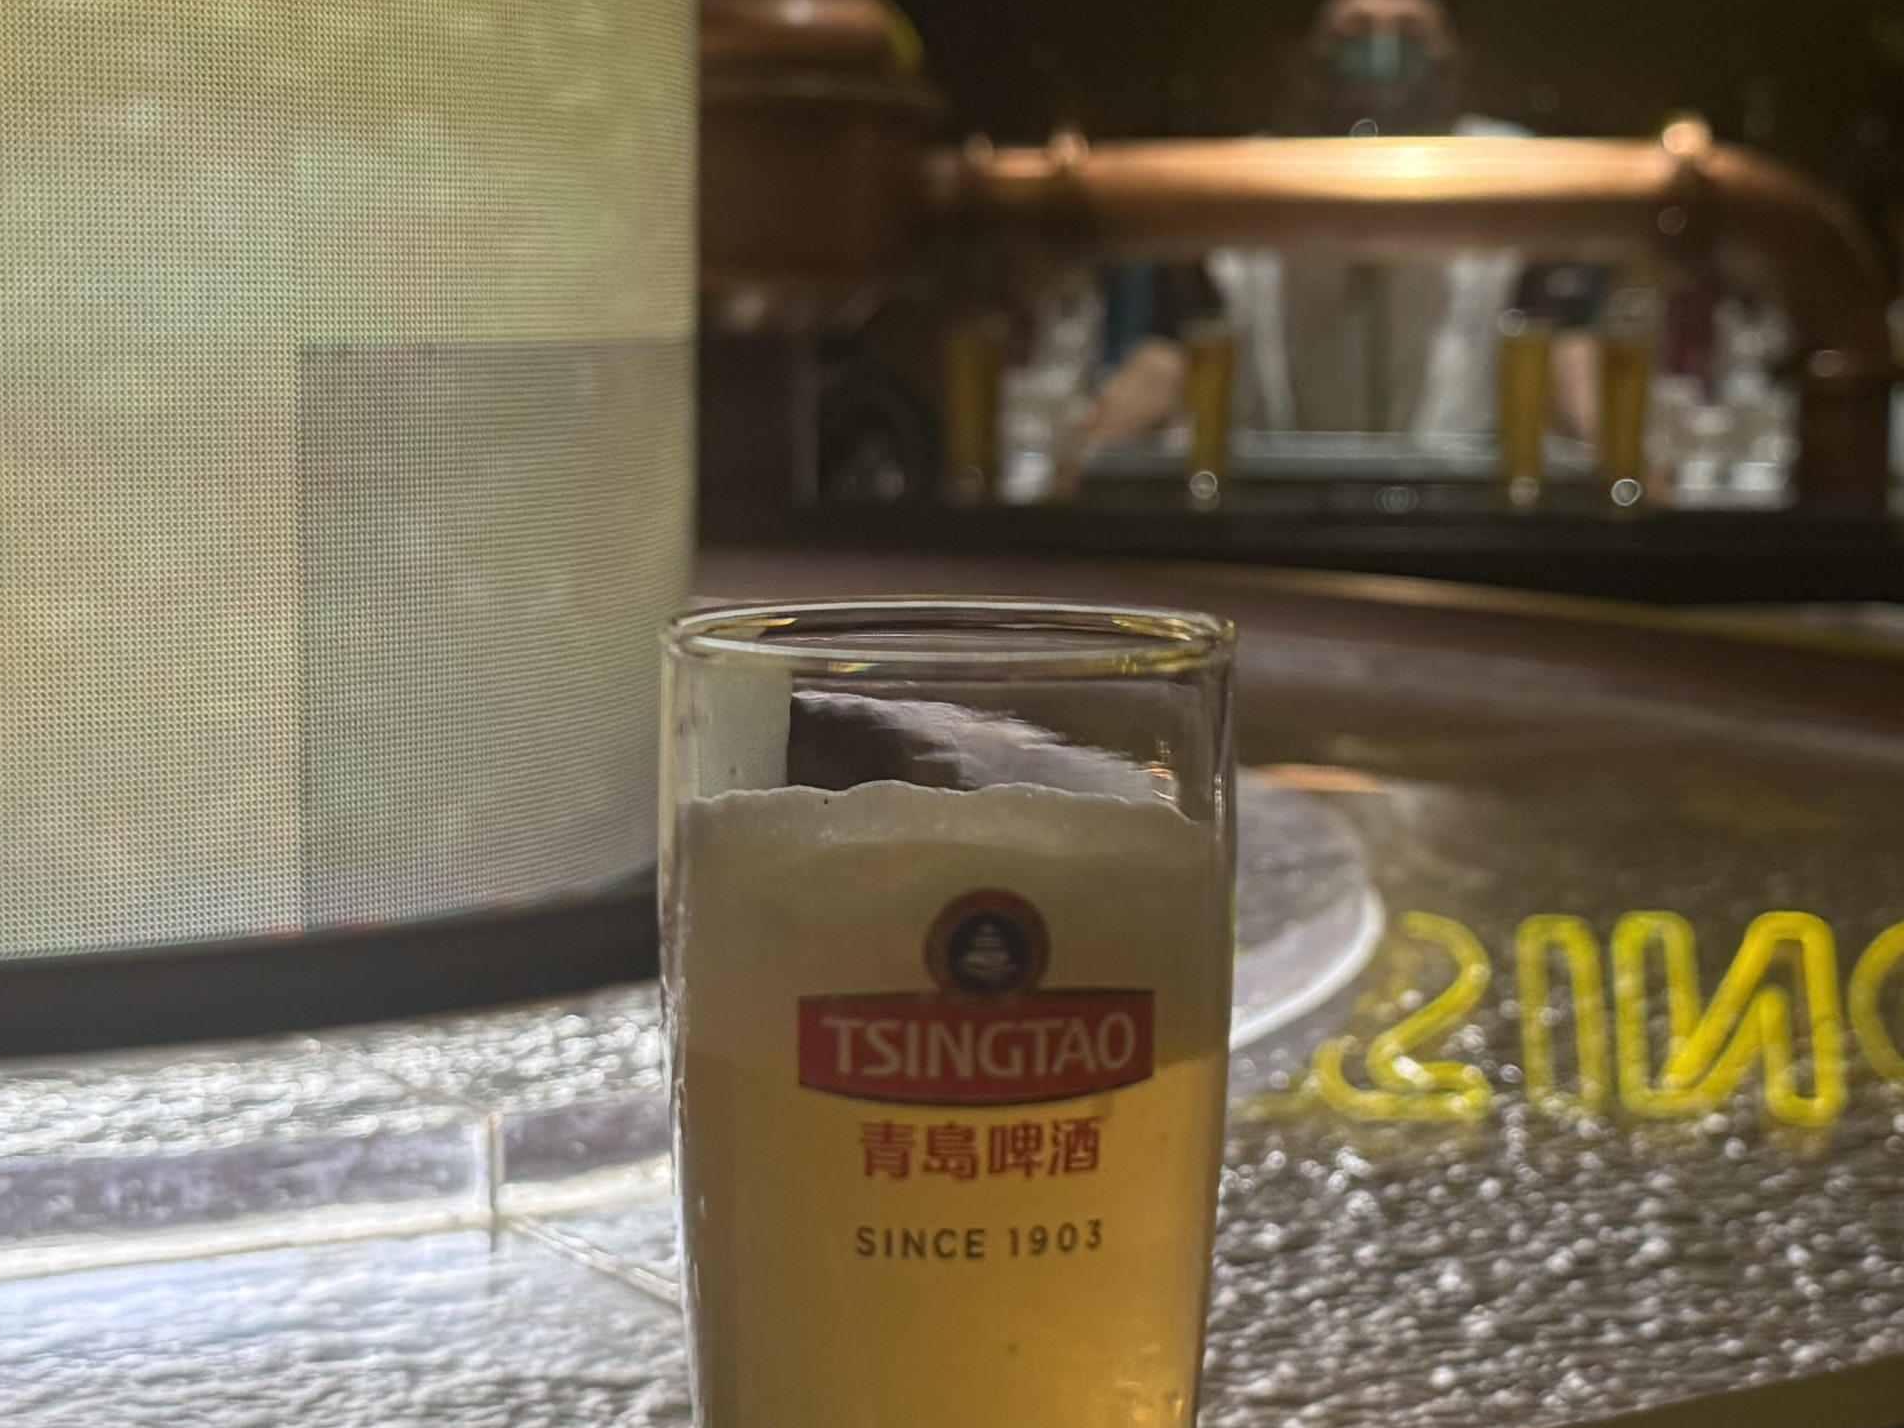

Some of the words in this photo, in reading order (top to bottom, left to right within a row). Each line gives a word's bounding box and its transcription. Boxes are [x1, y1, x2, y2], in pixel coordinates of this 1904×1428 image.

[821, 1011, 1137, 1079] TSINGTAO
[859, 1117, 1102, 1180] 青島啤酒
[856, 1226, 985, 1260] SINCE
[1007, 1218, 1104, 1257] 1903
